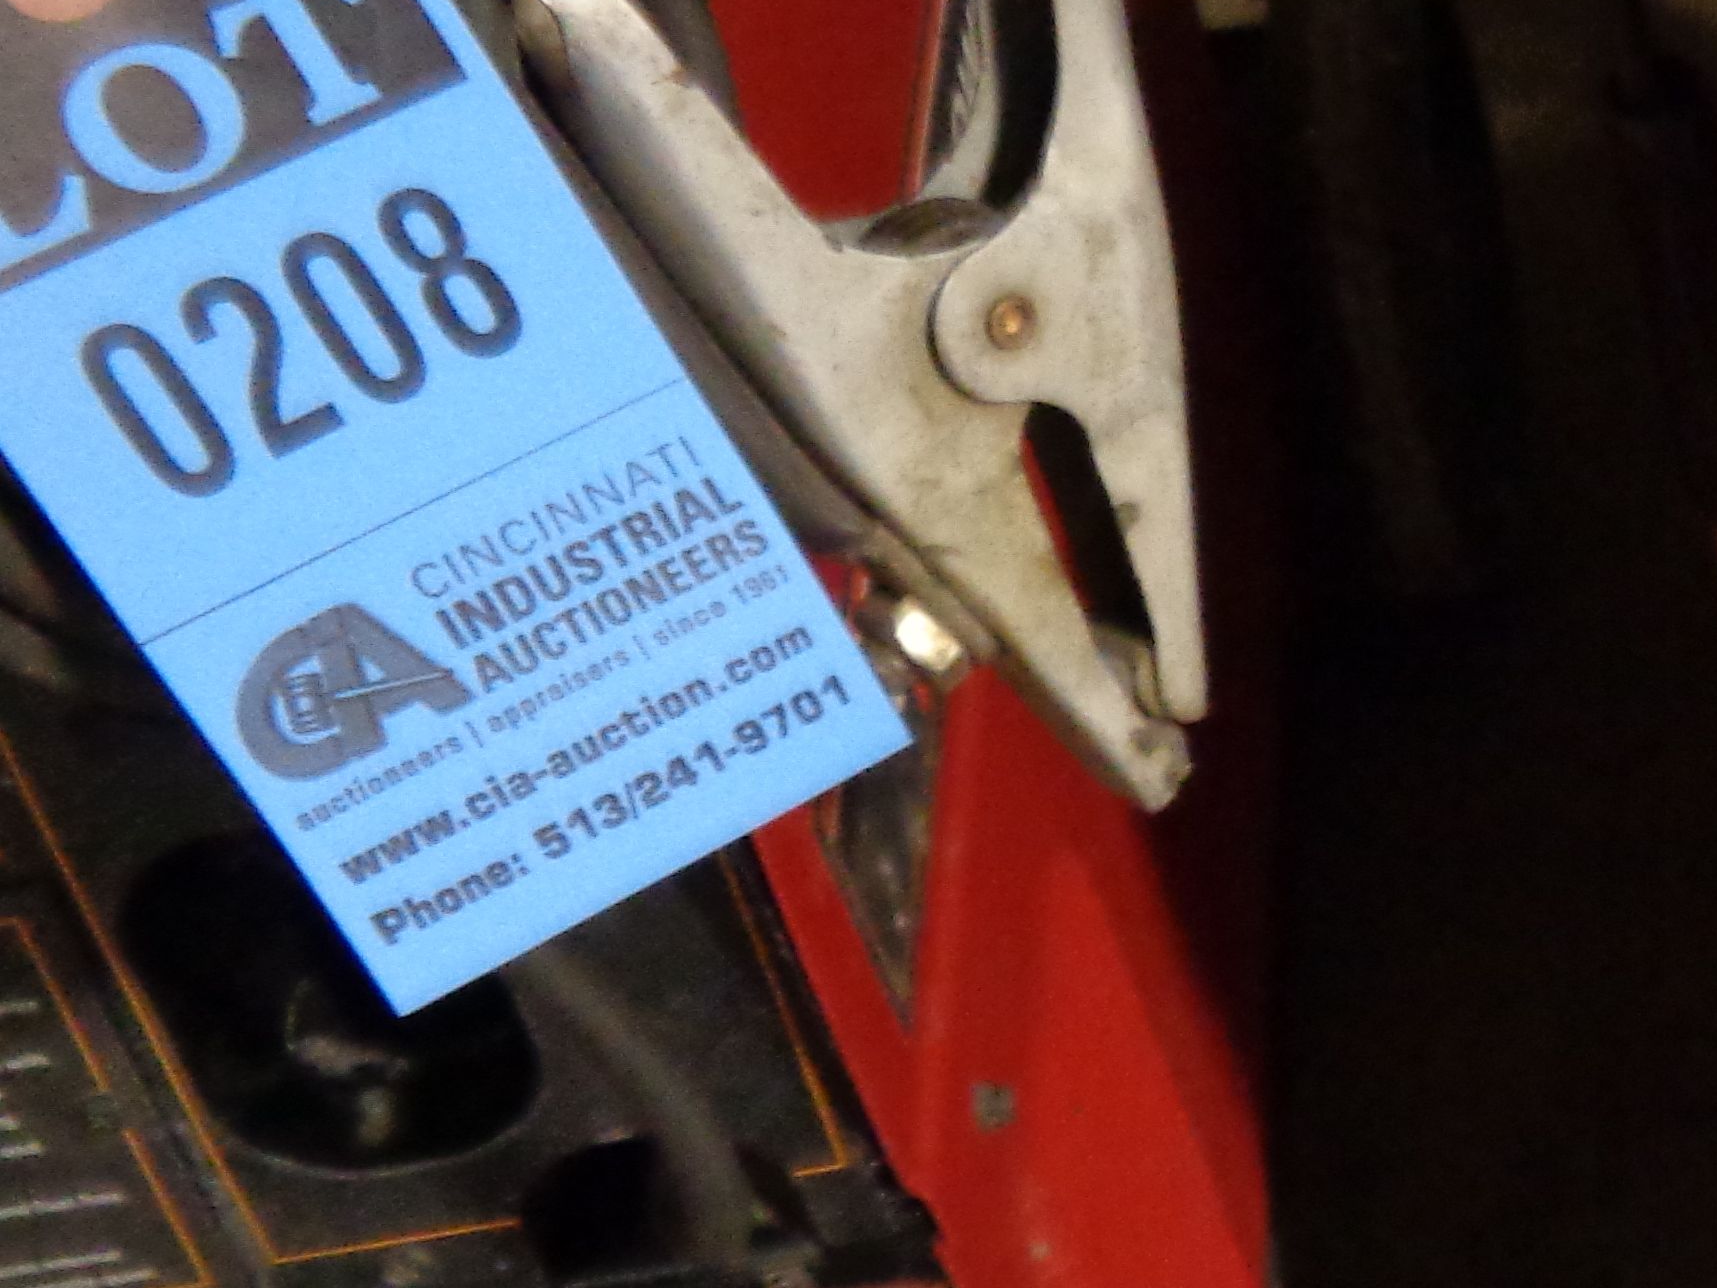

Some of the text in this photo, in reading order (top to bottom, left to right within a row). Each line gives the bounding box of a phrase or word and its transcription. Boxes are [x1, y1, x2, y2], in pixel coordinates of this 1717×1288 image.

[78, 186, 524, 499] 0208
[410, 435, 706, 601] CINCINNATI
[434, 476, 747, 650] INDUSTRIAL
[471, 519, 770, 694] AUCTIONEERS
[296, 732, 464, 833] auctioneers
[486, 642, 633, 737] appraisers
[653, 597, 729, 651] since
[336, 621, 817, 885] www.cia-auction.com
[369, 675, 853, 945] Phone: 513/241-9701
